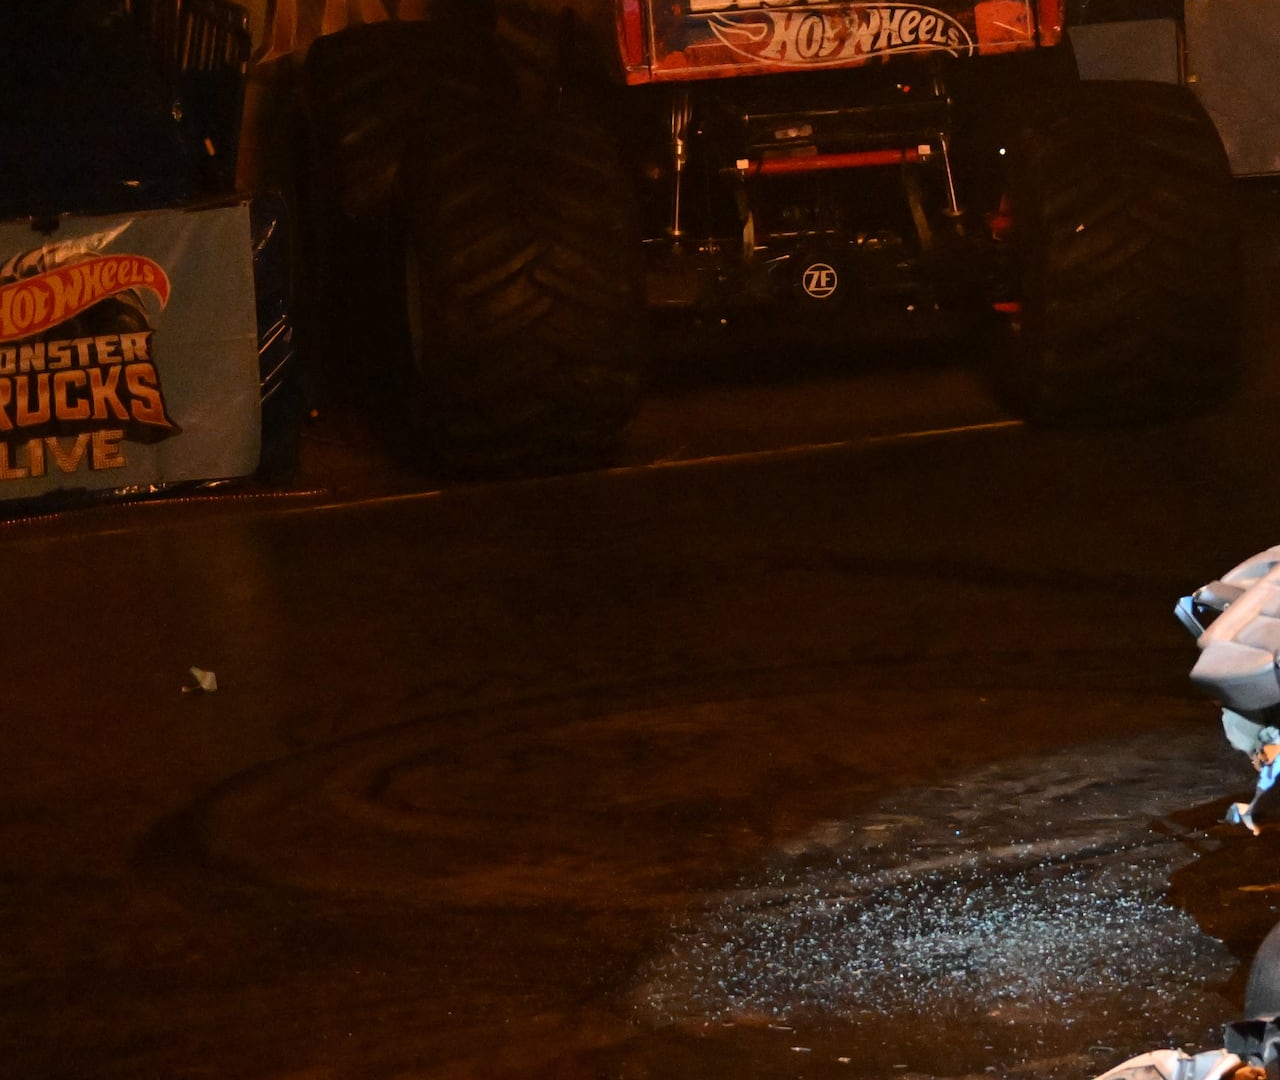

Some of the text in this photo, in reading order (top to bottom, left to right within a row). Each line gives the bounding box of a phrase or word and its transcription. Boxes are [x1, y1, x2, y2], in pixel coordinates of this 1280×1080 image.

[760, 12, 846, 61] HOT
[804, 268, 837, 293] ZF
[0, 331, 154, 375] ONSTER
[0, 429, 127, 480] LIVE
